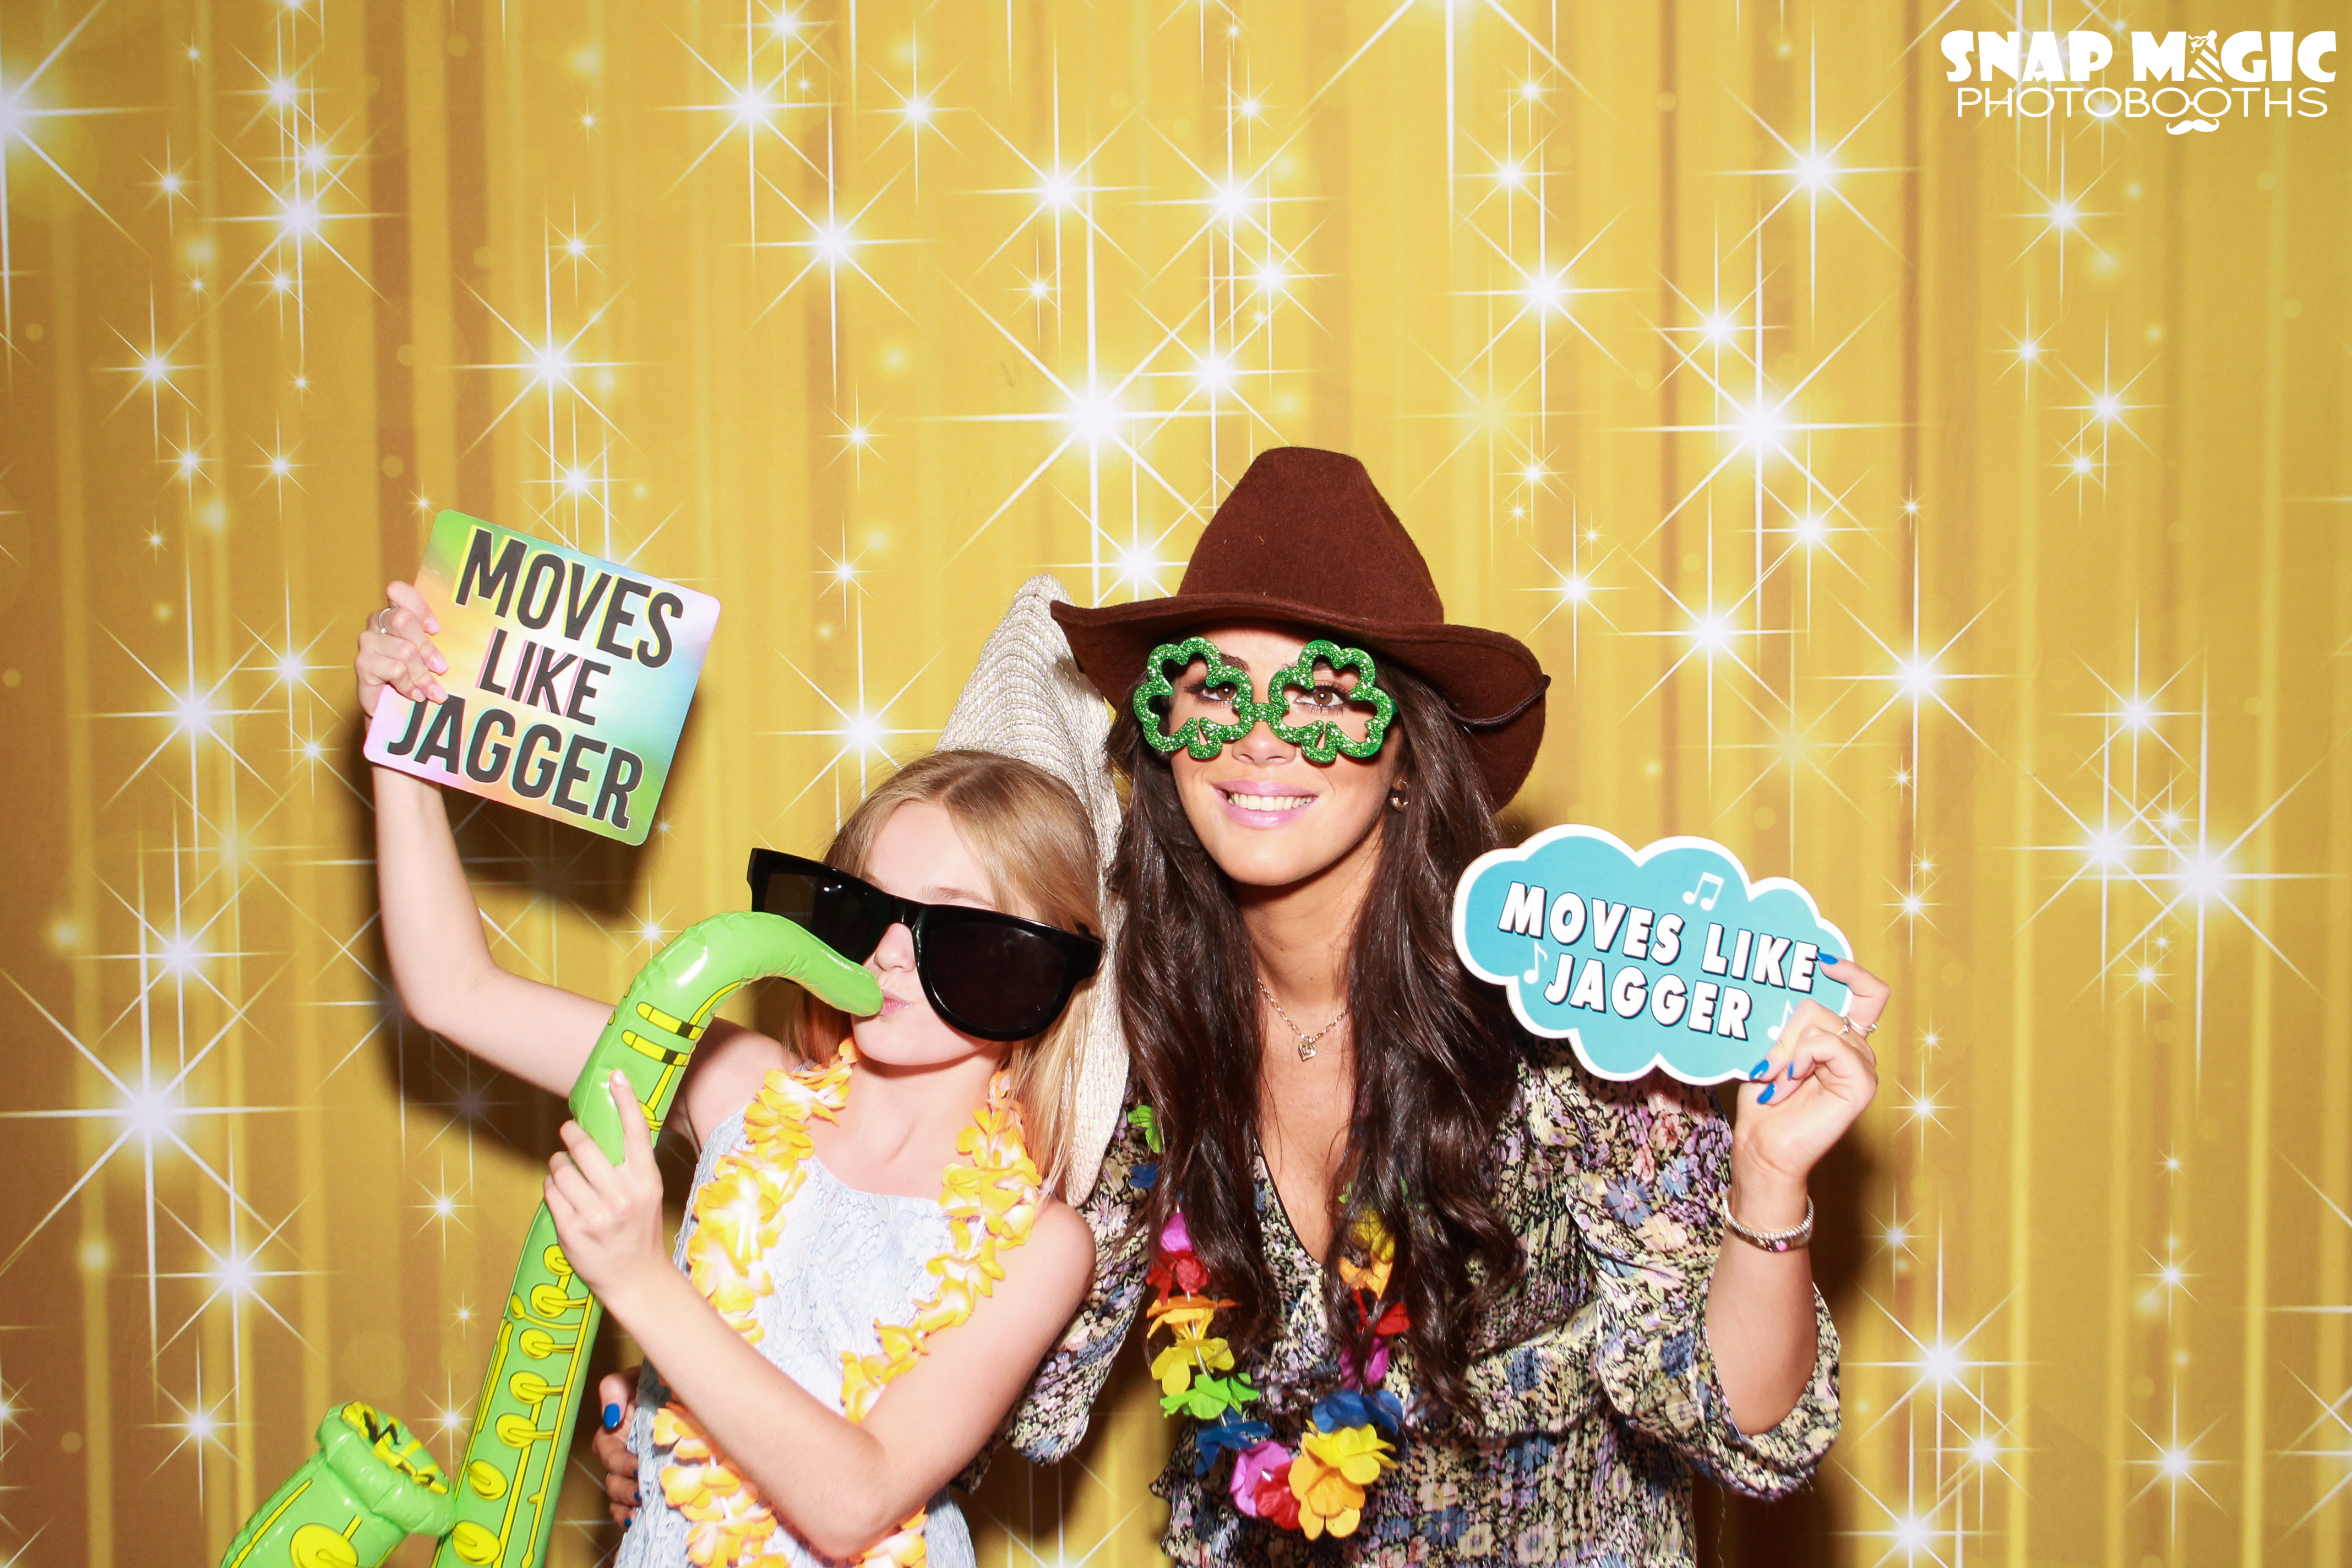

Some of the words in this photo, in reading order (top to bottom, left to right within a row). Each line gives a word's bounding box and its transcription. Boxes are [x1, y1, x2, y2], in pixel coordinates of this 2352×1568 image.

[452, 525, 684, 668] MOVES
[475, 627, 612, 726] LIKE
[386, 694, 643, 830] JAGGER
[1498, 880, 1686, 966] MOVES
[1701, 922, 1819, 993] LIKE
[1544, 952, 1752, 1041] JAGGER
